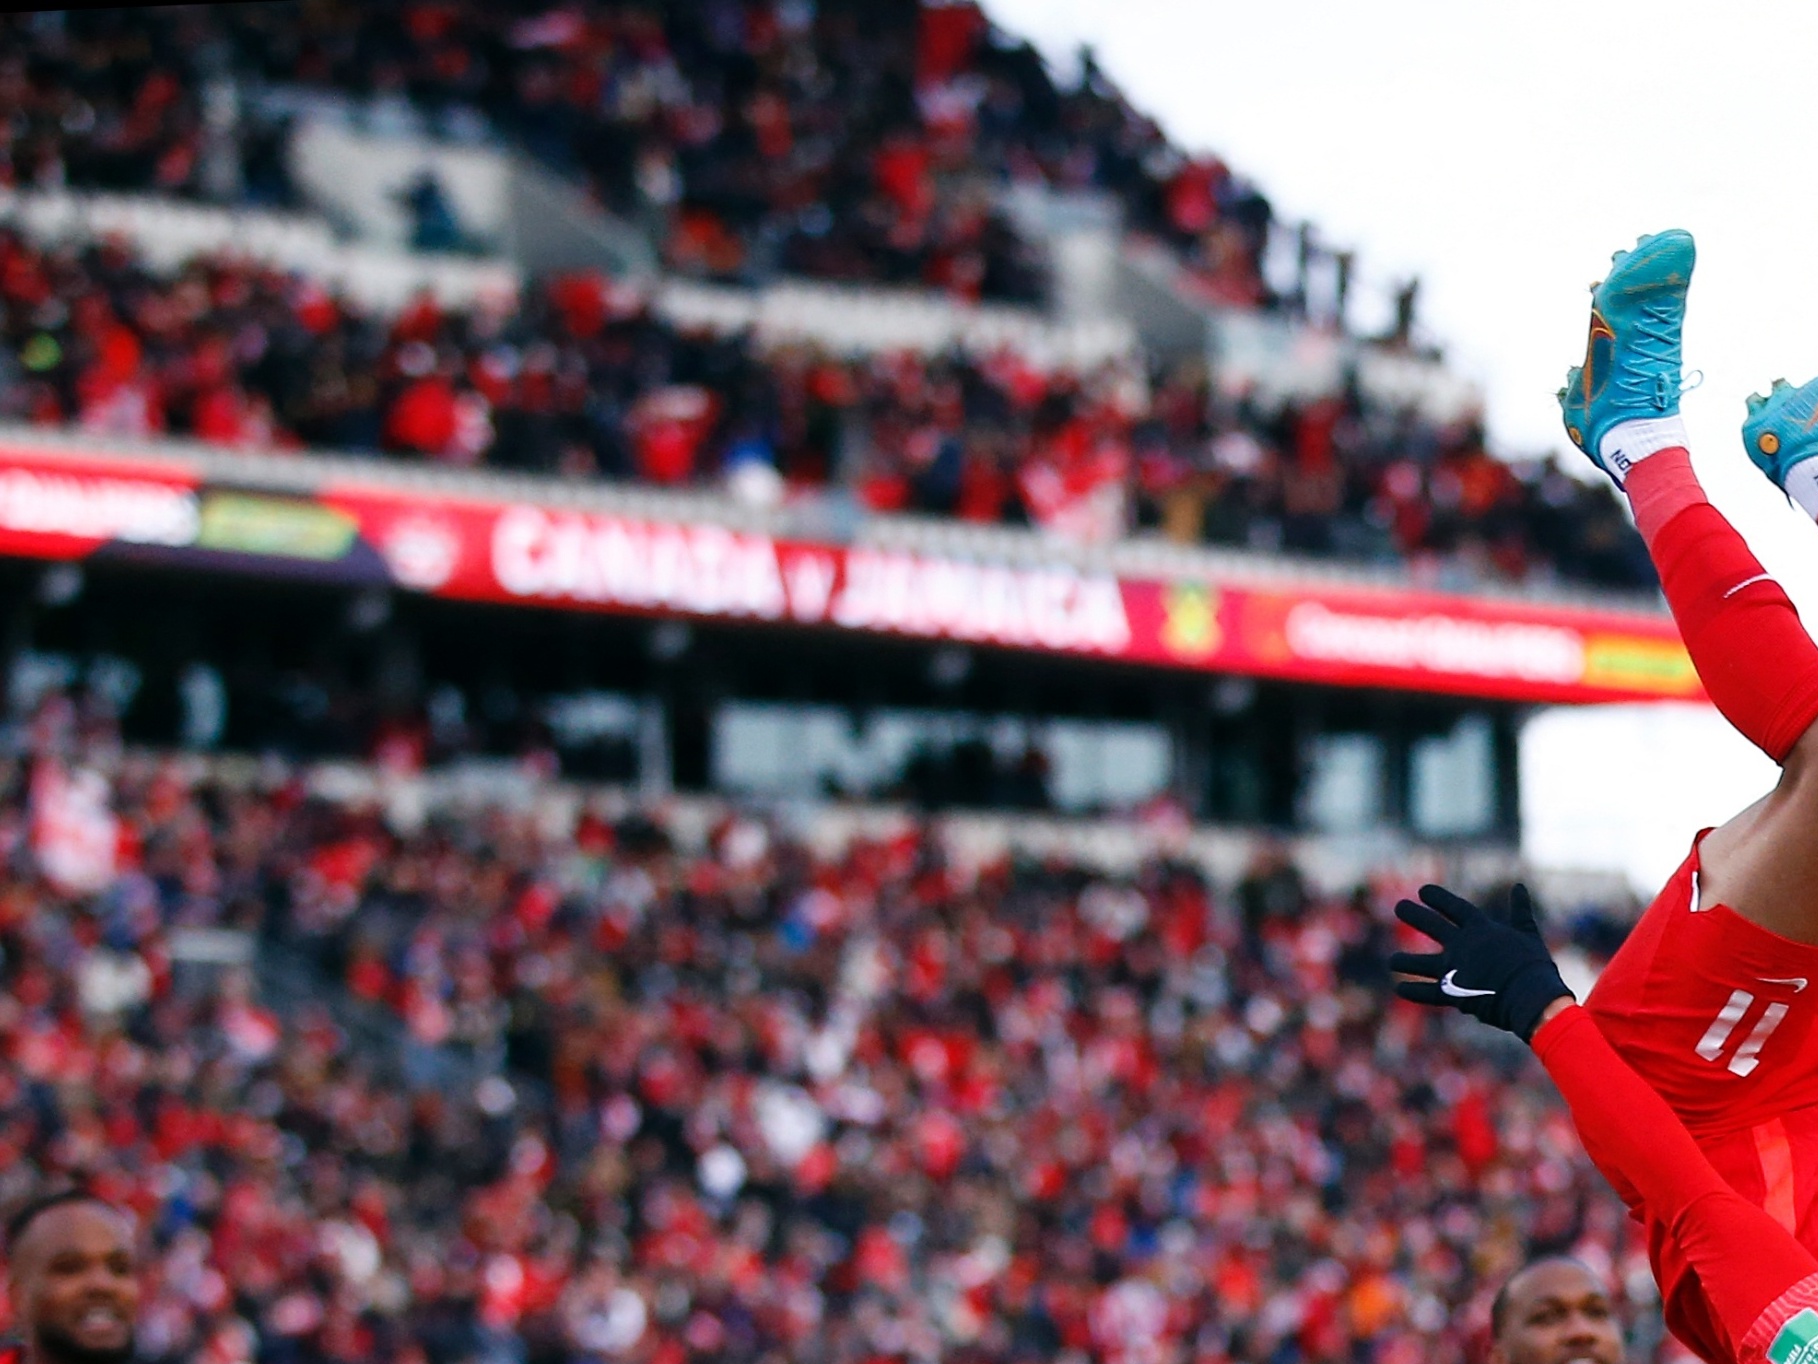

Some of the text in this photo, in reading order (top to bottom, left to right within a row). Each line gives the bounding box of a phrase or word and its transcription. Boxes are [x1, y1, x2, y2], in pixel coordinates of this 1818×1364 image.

[490, 507, 786, 622] CANADA
[833, 550, 1132, 655] JAMAICA
[1694, 989, 1789, 1078] 11
